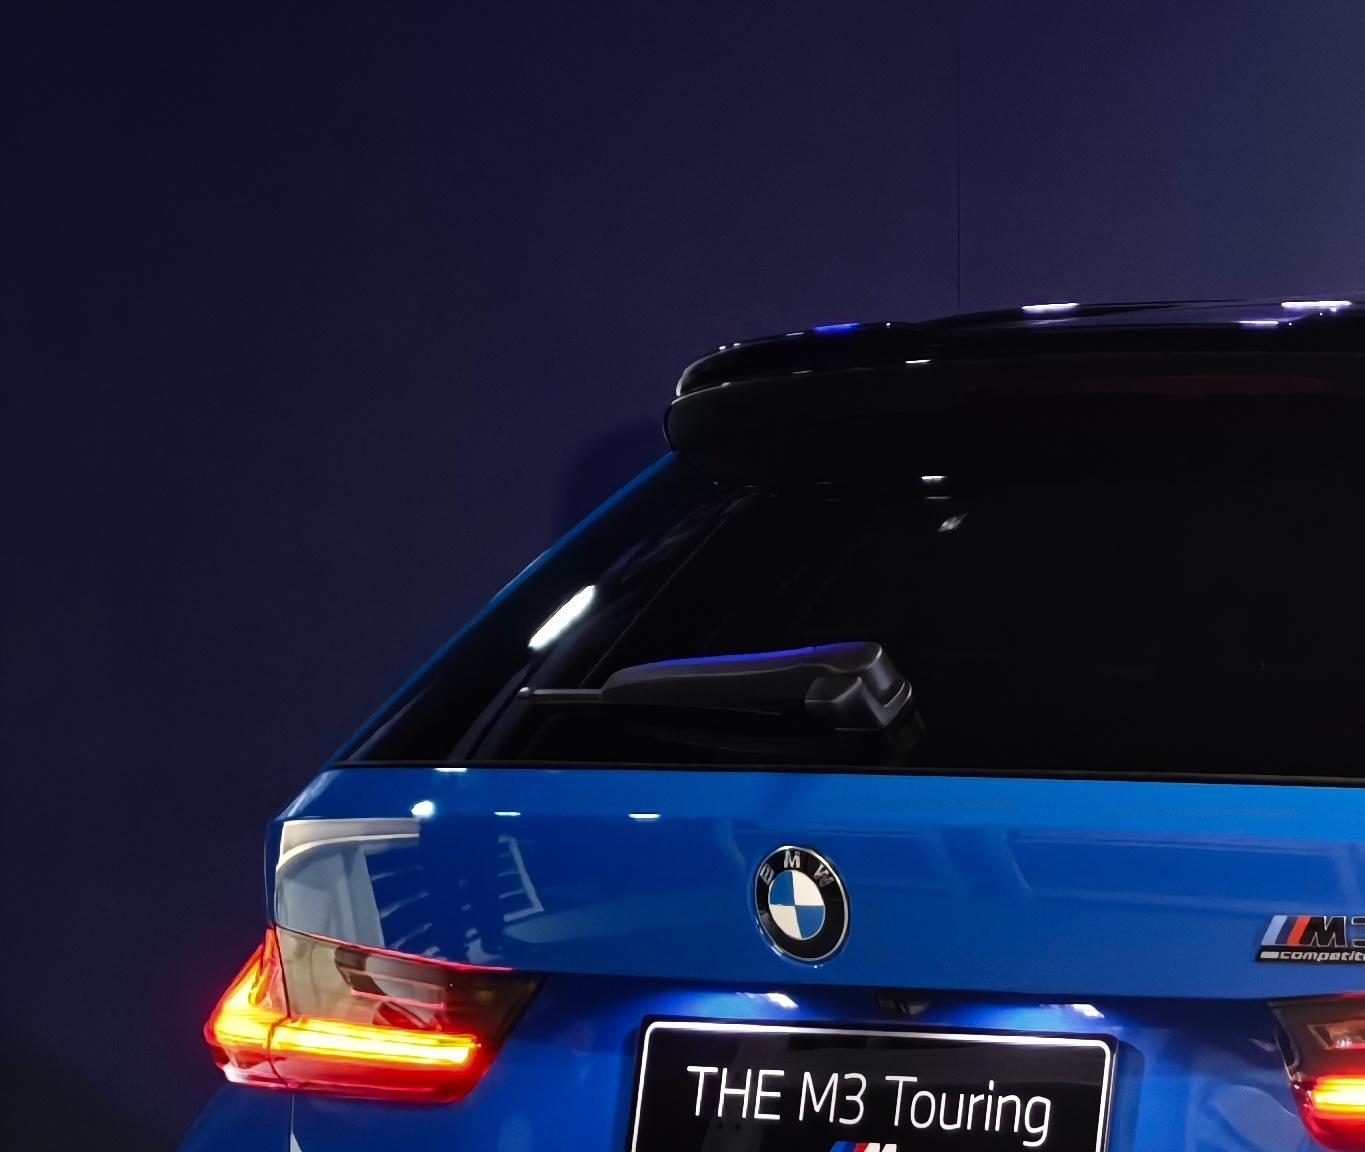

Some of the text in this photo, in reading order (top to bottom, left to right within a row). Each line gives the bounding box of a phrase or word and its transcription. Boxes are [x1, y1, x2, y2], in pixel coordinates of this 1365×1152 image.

[759, 850, 835, 888] BMW
[686, 1065, 1051, 1148] THE M3 Touring
